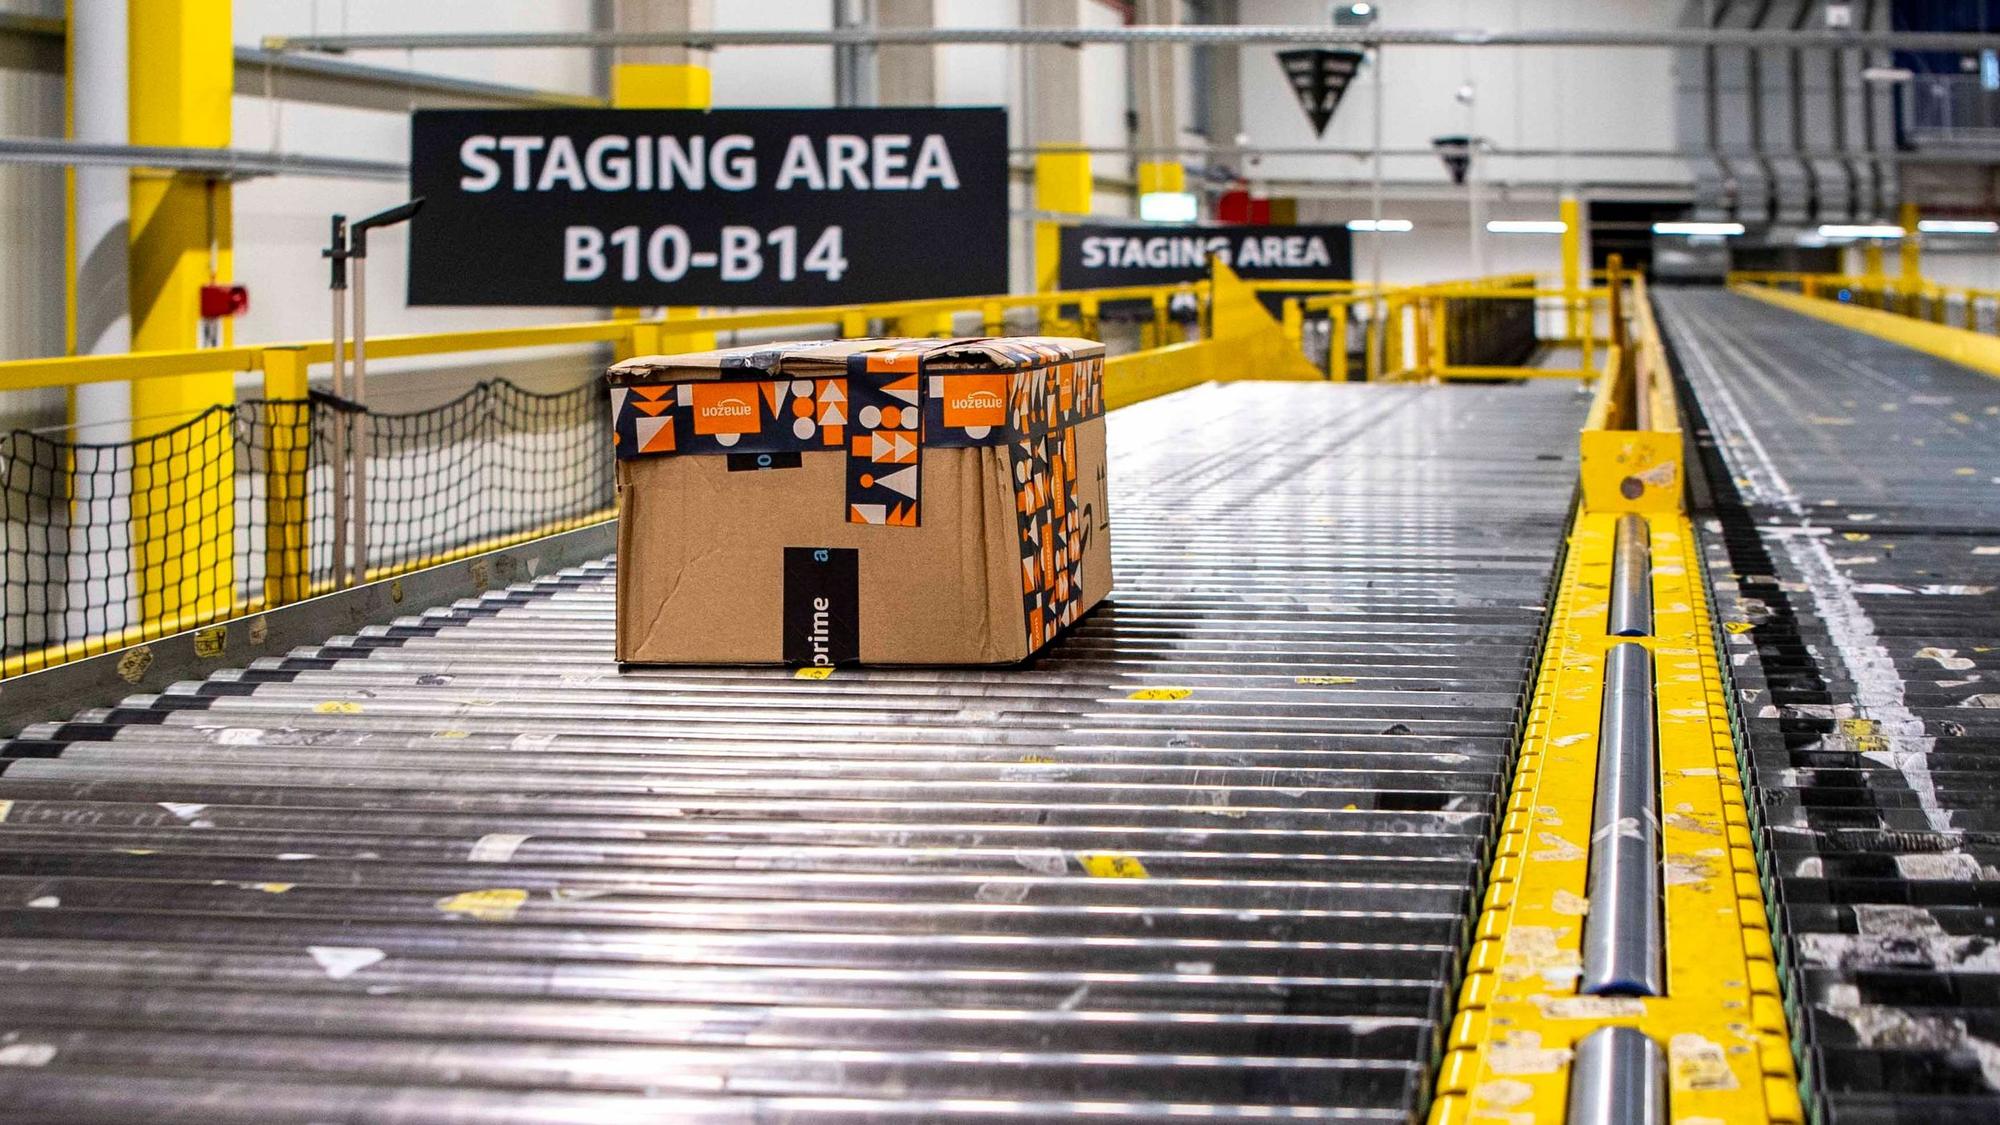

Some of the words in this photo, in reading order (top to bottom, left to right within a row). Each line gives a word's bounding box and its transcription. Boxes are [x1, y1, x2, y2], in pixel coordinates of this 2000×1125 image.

[459, 136, 757, 192] STAGING
[776, 135, 960, 191] AREA
[564, 226, 848, 282] B10-B14
[1081, 236, 1232, 268] STAGING
[1237, 236, 1331, 268] AREA
[702, 405, 752, 417] amazon
[952, 398, 1003, 410] amazon
[808, 597, 835, 667] prime
